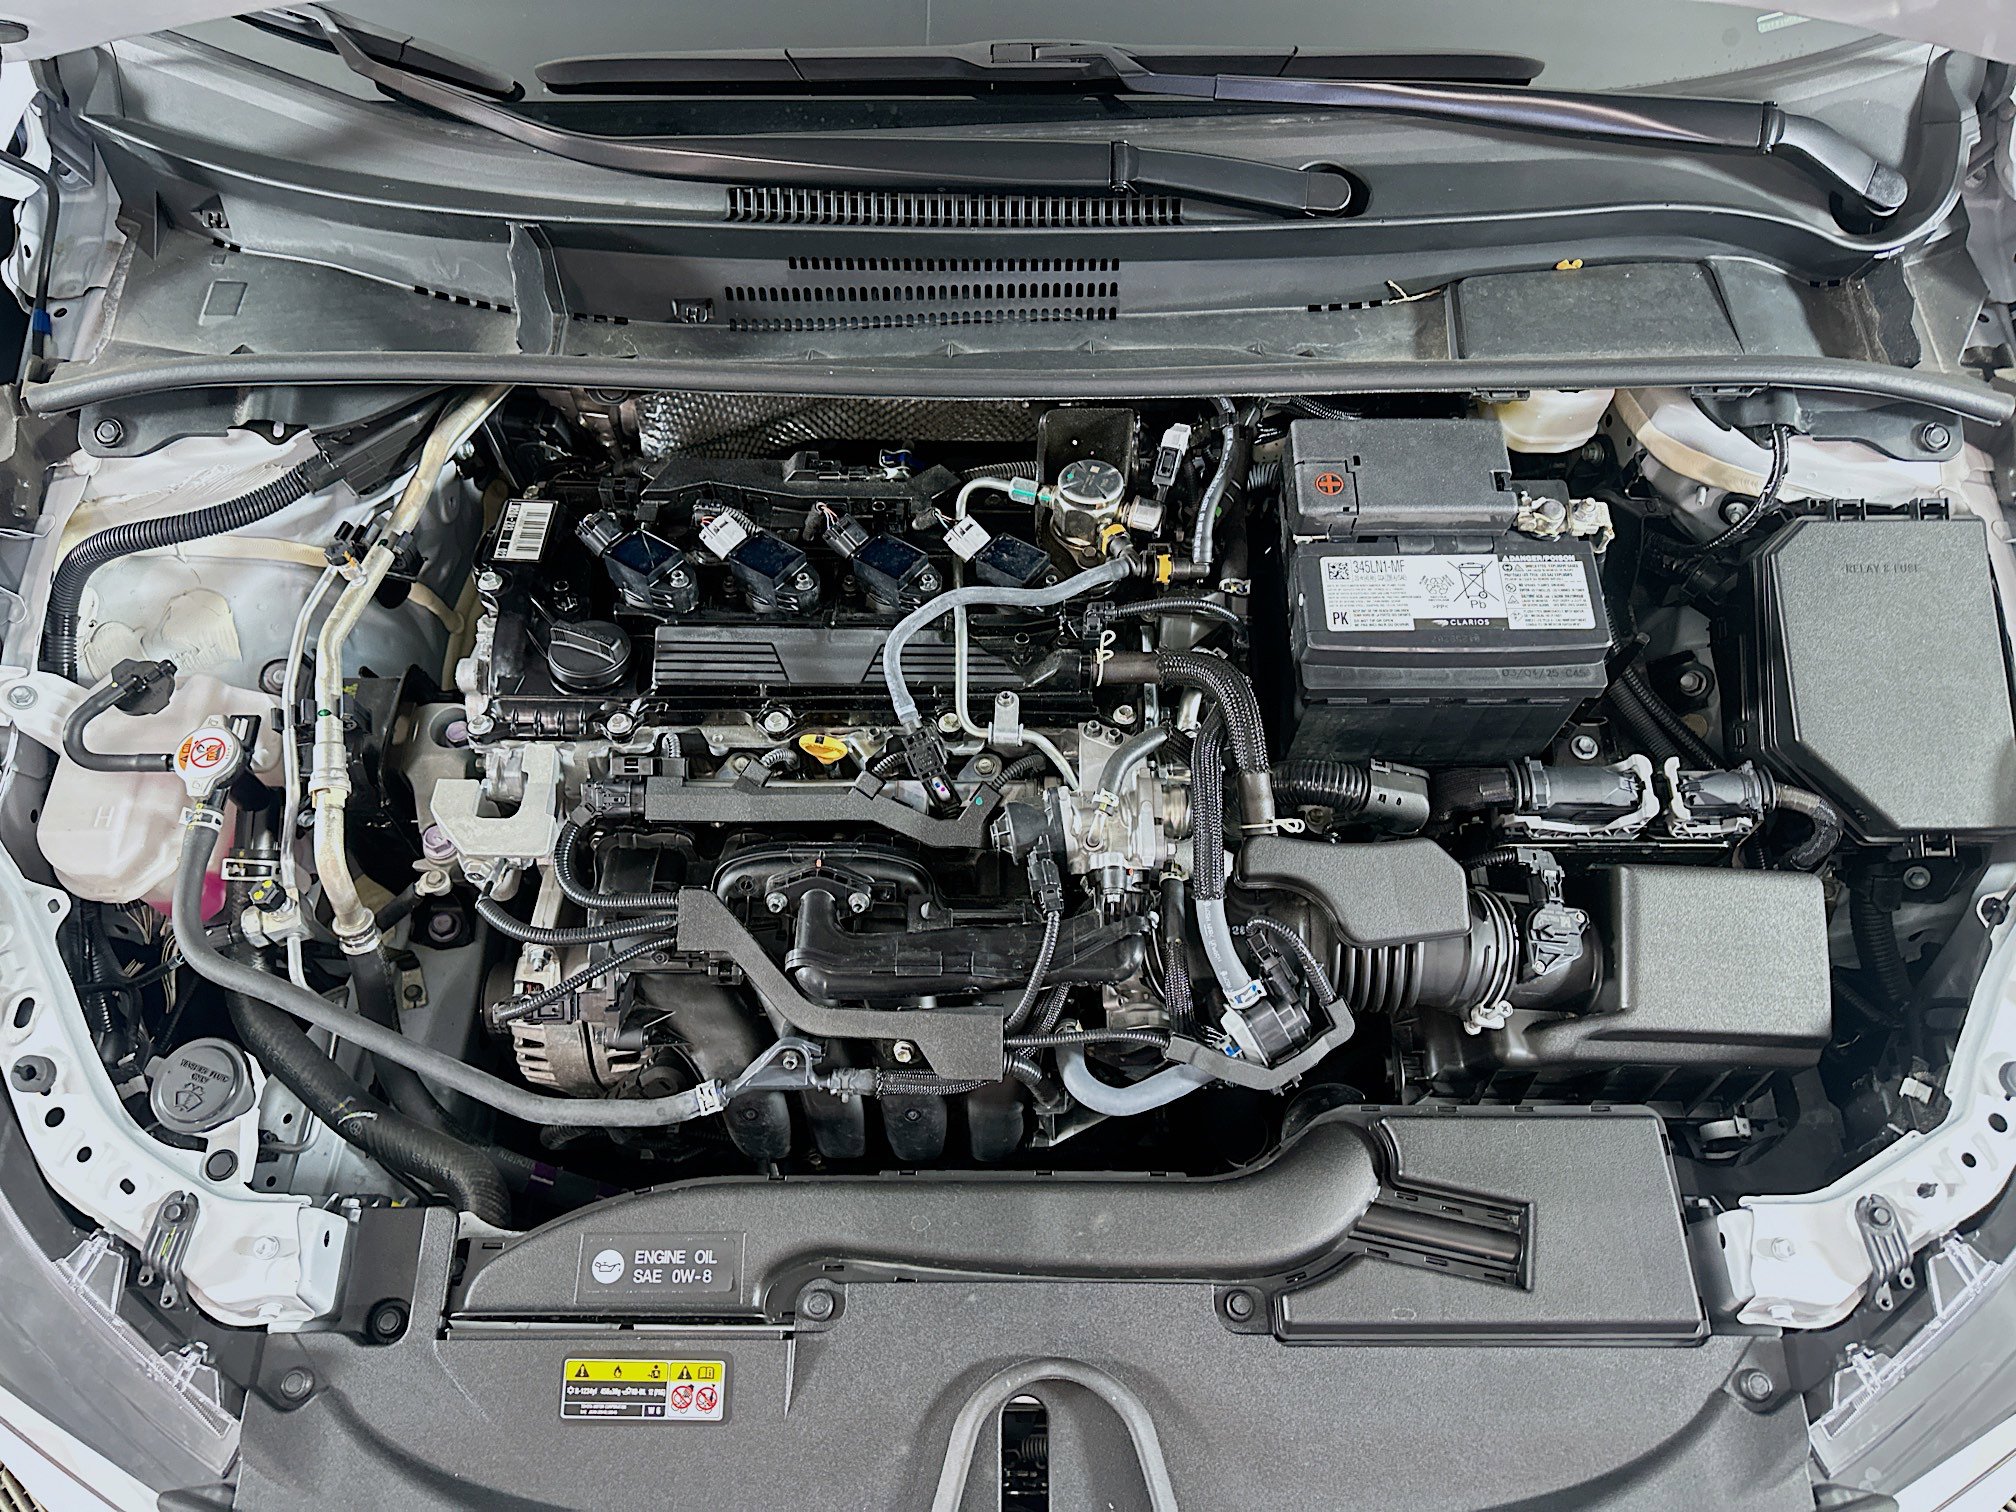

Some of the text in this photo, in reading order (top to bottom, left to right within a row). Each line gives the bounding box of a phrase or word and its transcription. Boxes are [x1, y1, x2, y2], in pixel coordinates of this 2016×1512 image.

[1353, 559, 1405, 574] 345LN1-MF
[1470, 600, 1487, 609] Pb
[1332, 611, 1349, 625] PK
[1450, 618, 1490, 626] CLARIOS
[634, 1250, 717, 1265] ENGINE OIL
[632, 1269, 712, 1284] SAE 0W-8
